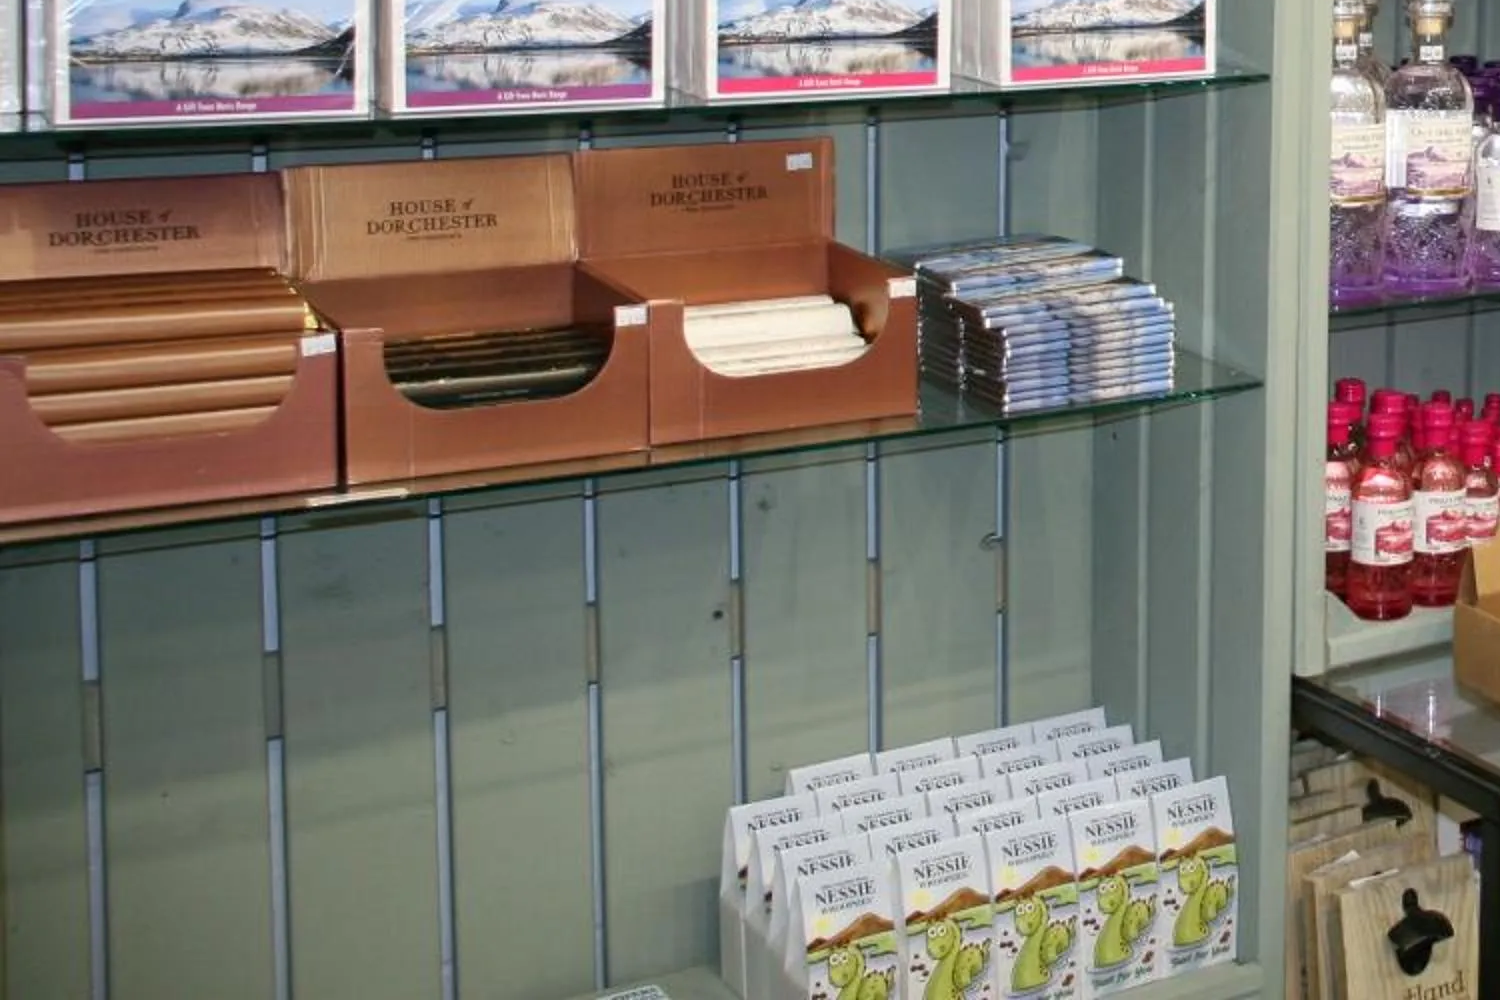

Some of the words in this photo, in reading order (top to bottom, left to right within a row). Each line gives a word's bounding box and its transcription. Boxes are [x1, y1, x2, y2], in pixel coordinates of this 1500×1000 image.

[672, 173, 730, 189] HOUSE
[389, 199, 456, 216] HOUSE
[650, 186, 768, 207] DORCHESTER
[75, 210, 152, 229] HOUSE
[366, 213, 499, 236] DORCHESTER
[48, 225, 201, 248] DORCHESTER
[1167, 796, 1217, 820] NESSIE
[747, 811, 802, 831] NESSIE
[858, 811, 913, 832] NESSIE
[972, 814, 1025, 834] NESSIE
[1085, 814, 1138, 838] NESSIE
[885, 832, 941, 855] NESSIE
[1001, 833, 1058, 858] NESSIE
[797, 853, 857, 877] NESSIE
[913, 855, 971, 881] NESSIE
[815, 880, 876, 906] NESSIE
